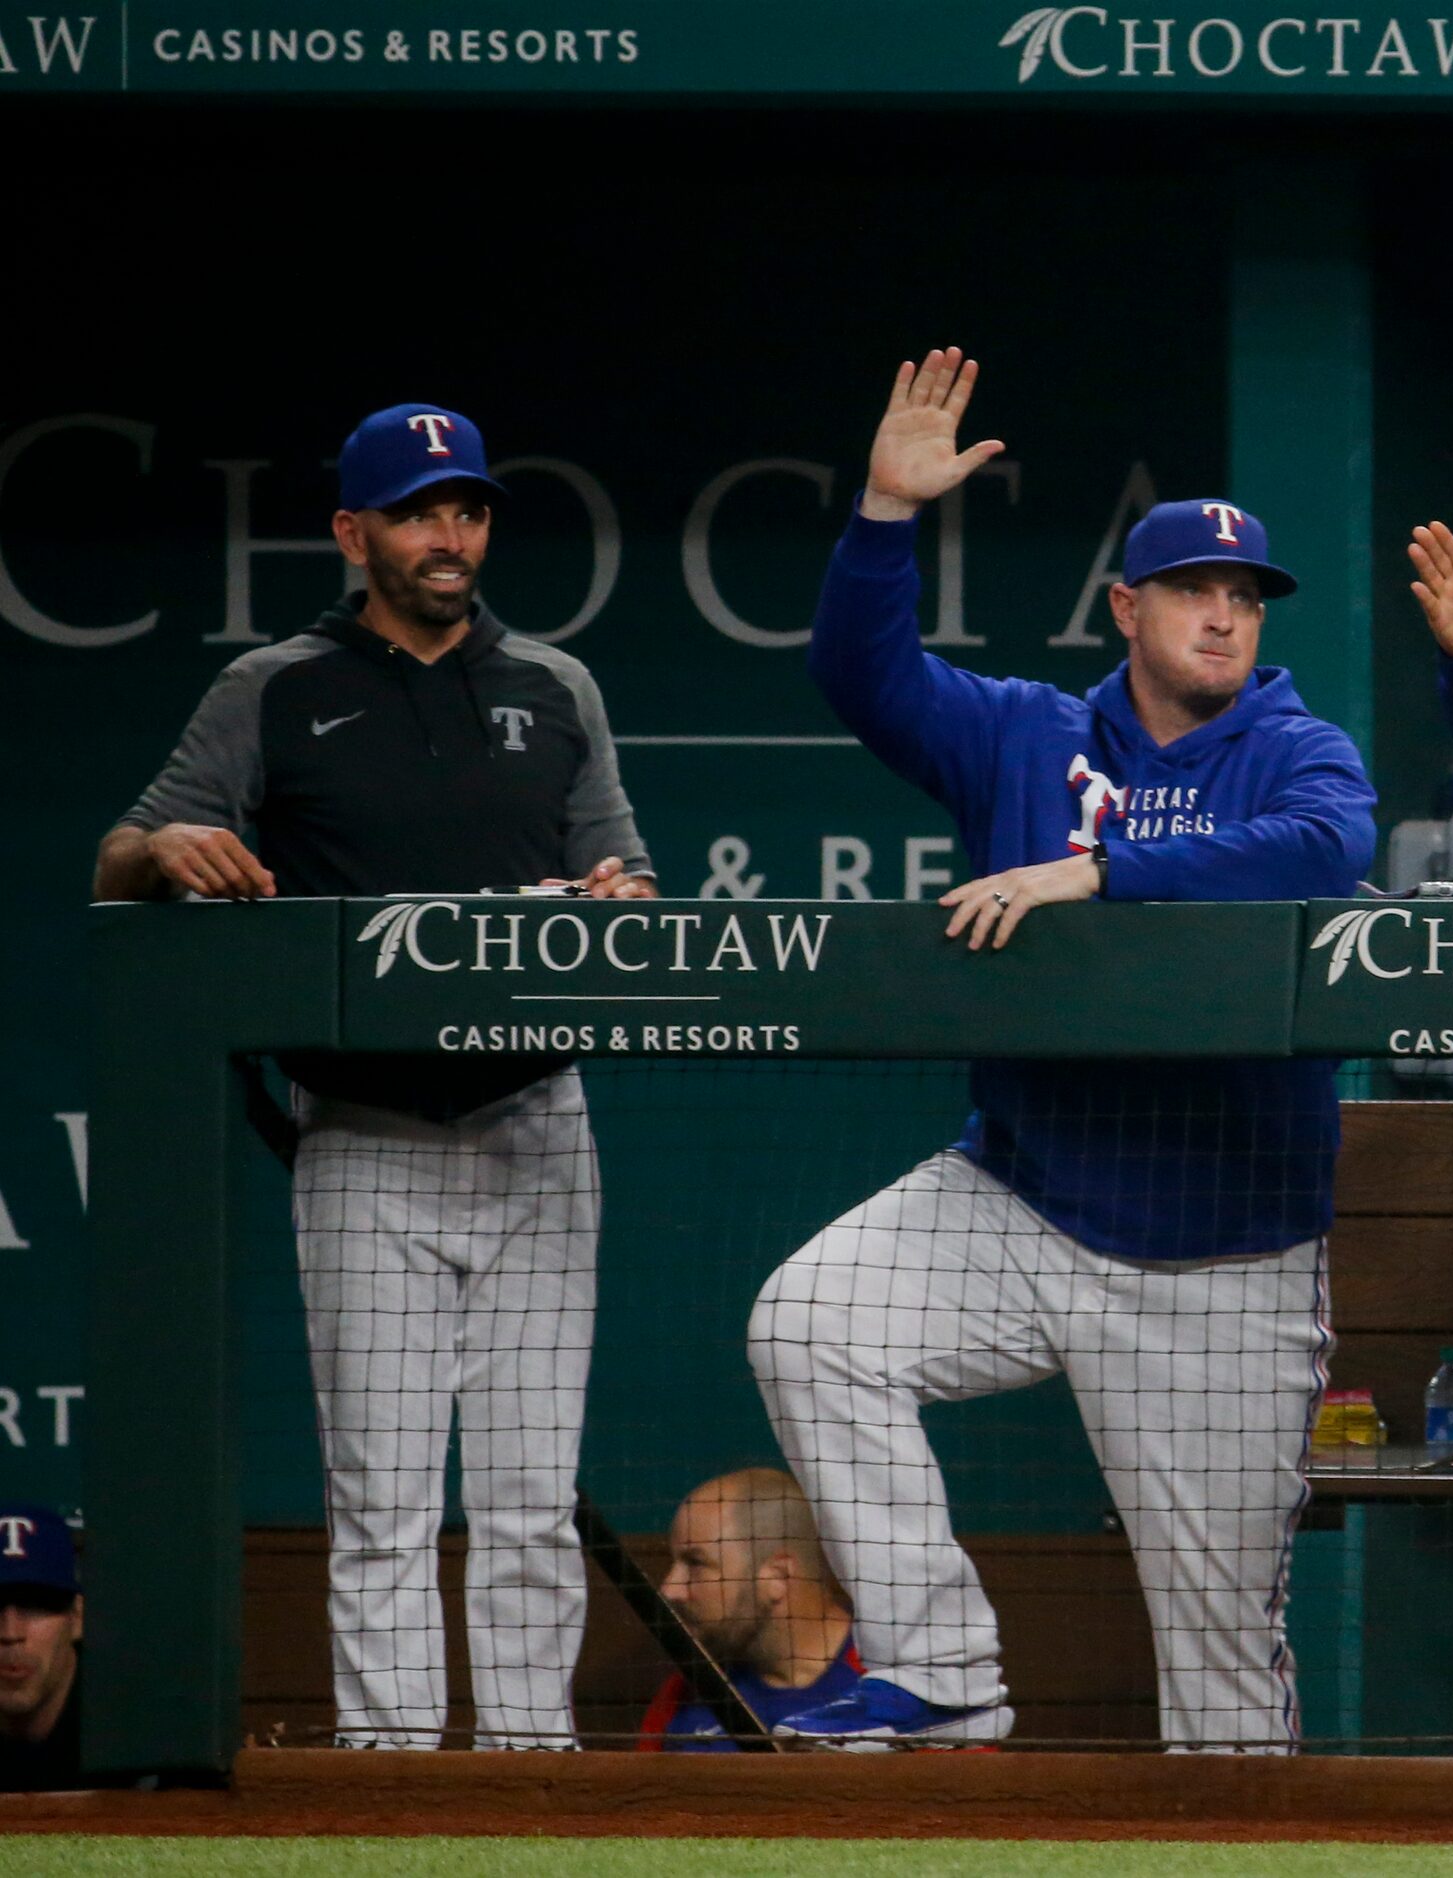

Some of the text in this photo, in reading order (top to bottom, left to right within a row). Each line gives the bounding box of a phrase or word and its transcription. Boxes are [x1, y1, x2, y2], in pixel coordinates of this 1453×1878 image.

[153, 29, 639, 63] CASINOS & RESORTS
[407, 413, 456, 457] T
[1202, 502, 1245, 545] T
[490, 706, 533, 751] T
[1066, 753, 1131, 853] T
[402, 901, 832, 972] CHOCTAW
[438, 1025, 800, 1052] CASINOS & RESORTS
